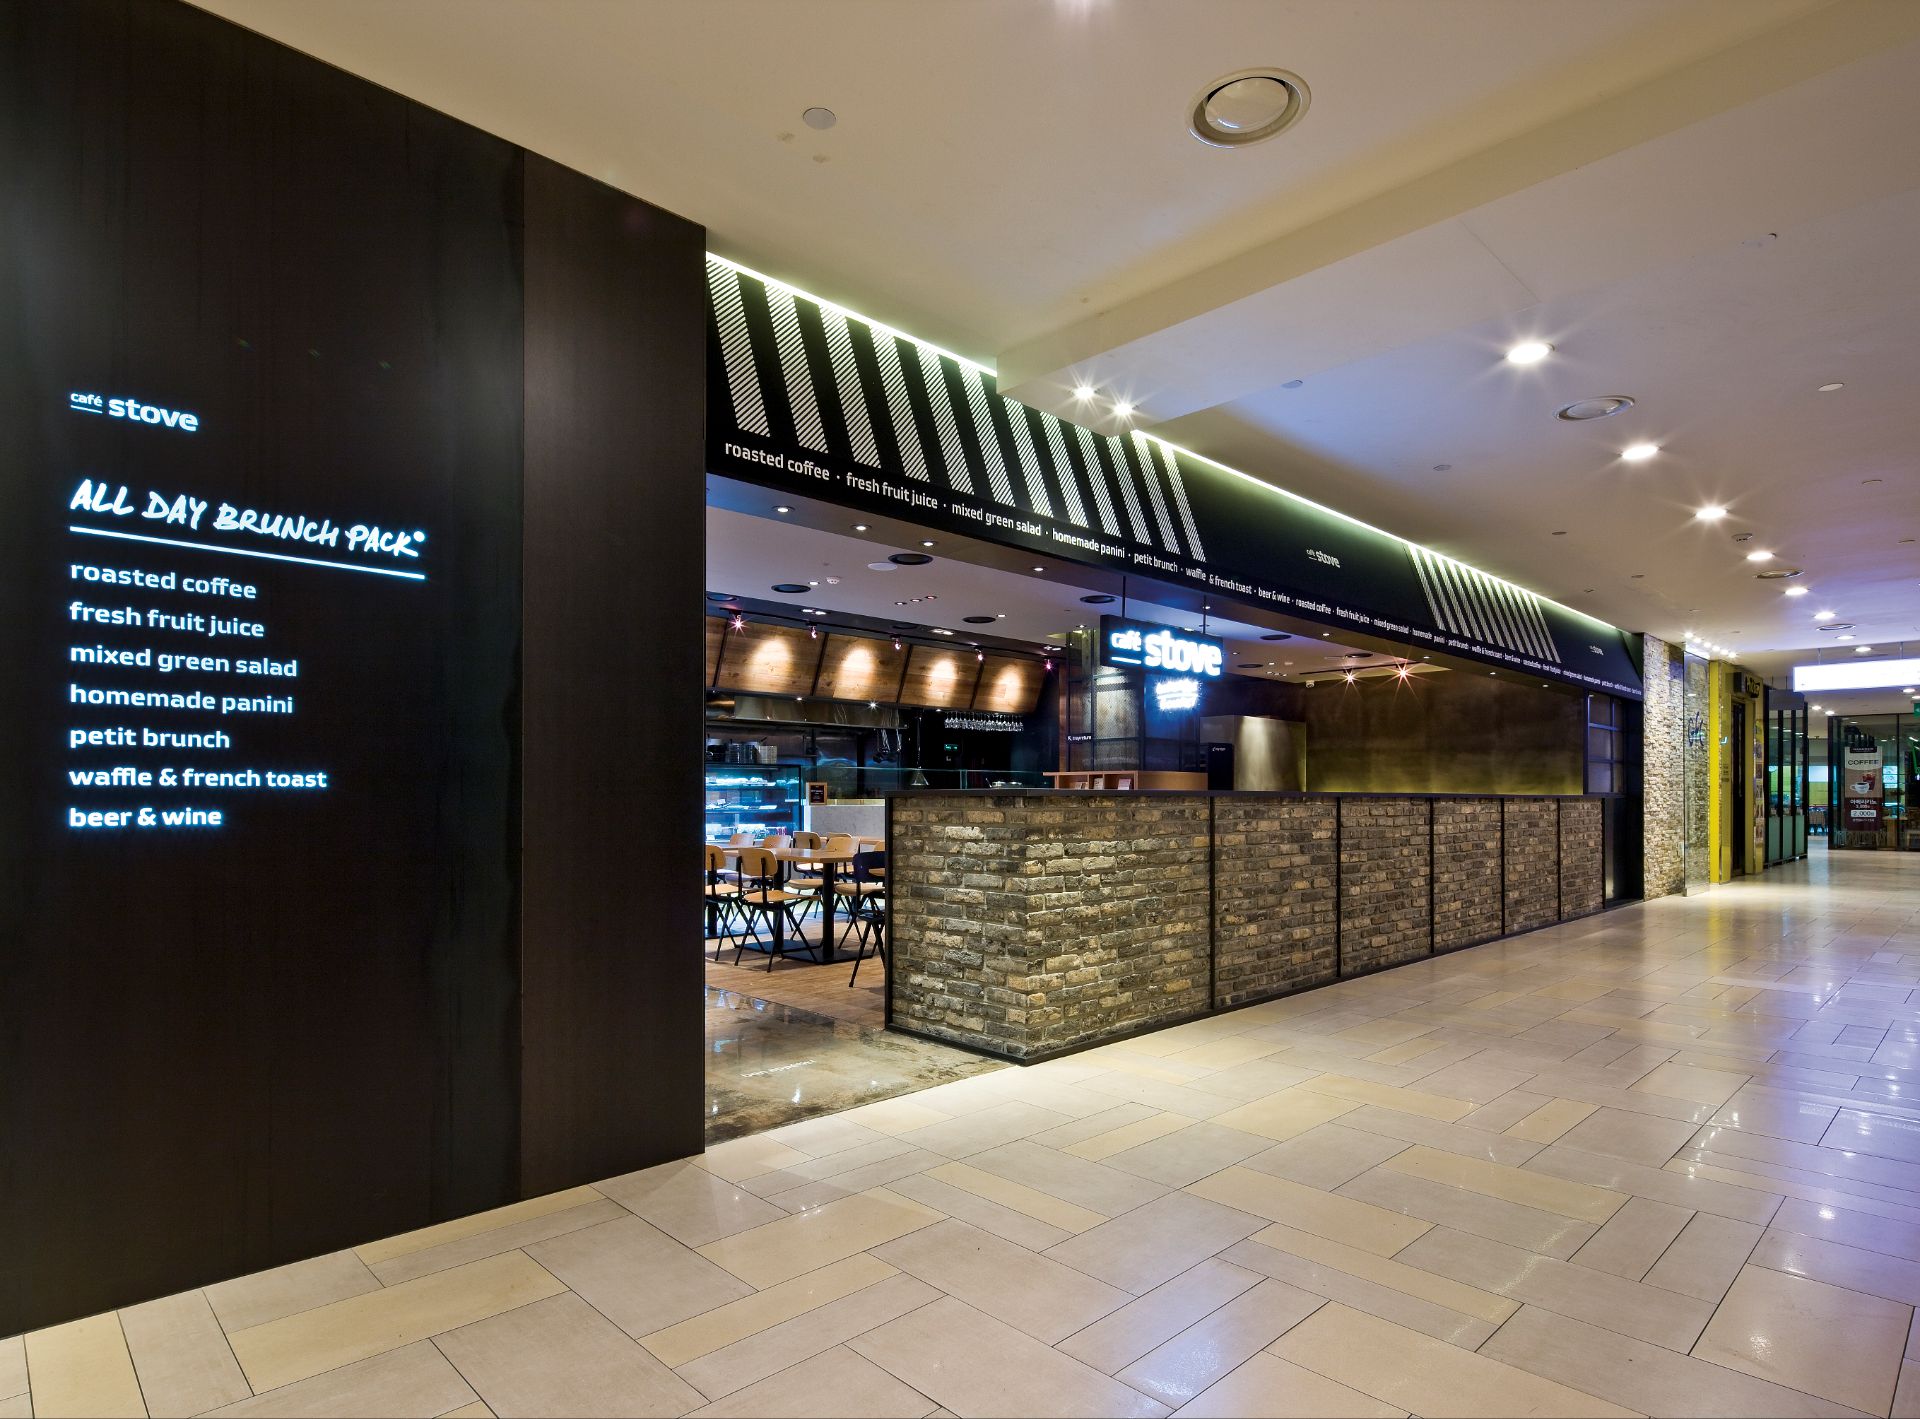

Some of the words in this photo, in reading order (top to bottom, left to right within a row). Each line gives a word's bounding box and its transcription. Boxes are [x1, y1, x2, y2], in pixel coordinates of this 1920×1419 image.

[70, 391, 102, 406] café
[108, 398, 199, 432] stove
[70, 479, 134, 515] ALL
[142, 491, 208, 529] DAY
[213, 503, 339, 547] BRUNCH
[725, 442, 784, 469] roasted
[787, 459, 830, 481] coffee
[846, 472, 880, 494] fresh
[882, 482, 910, 502] fruit
[912, 489, 938, 509] juice
[952, 502, 983, 521] mixed
[985, 512, 1014, 530] green
[1016, 520, 1041, 536] salad
[1052, 528, 1099, 552] homemade
[1100, 544, 1125, 559] panini
[1134, 552, 1153, 566] petit
[1154, 558, 1178, 573] brunch
[1186, 568, 1206, 581] waffle
[1209, 574, 1215, 585] &
[1215, 576, 1235, 591] french
[1236, 582, 1252, 595] toast
[1258, 587, 1271, 599] beer
[1272, 591, 1277, 601] &
[1277, 592, 1290, 604] wine
[1296, 598, 1316, 611] roasted
[1316, 603, 1331, 615] coffee
[1336, 606, 1349, 619] fresh
[1349, 610, 1360, 621] fruit
[1359, 614, 1370, 624] juice
[1316, 550, 1340, 568] stove
[70, 564, 175, 590] roasted
[182, 576, 257, 599] coffee
[70, 602, 141, 626] fresh
[148, 610, 204, 632] fruit
[208, 616, 264, 637] juice
[70, 645, 151, 667] mixed
[158, 652, 230, 672] green
[236, 657, 297, 677] salad
[1111, 630, 1141, 651] café
[1145, 630, 1222, 676] stove
[70, 684, 216, 710] homemade
[222, 696, 294, 714] panini
[70, 727, 137, 749] petit
[143, 728, 230, 748] brunch
[69, 768, 152, 787] waffle
[158, 768, 177, 787] &
[182, 769, 261, 787] french
[266, 771, 328, 788] toast
[70, 808, 132, 827] beer
[137, 808, 156, 827] &
[162, 807, 222, 826] wine
